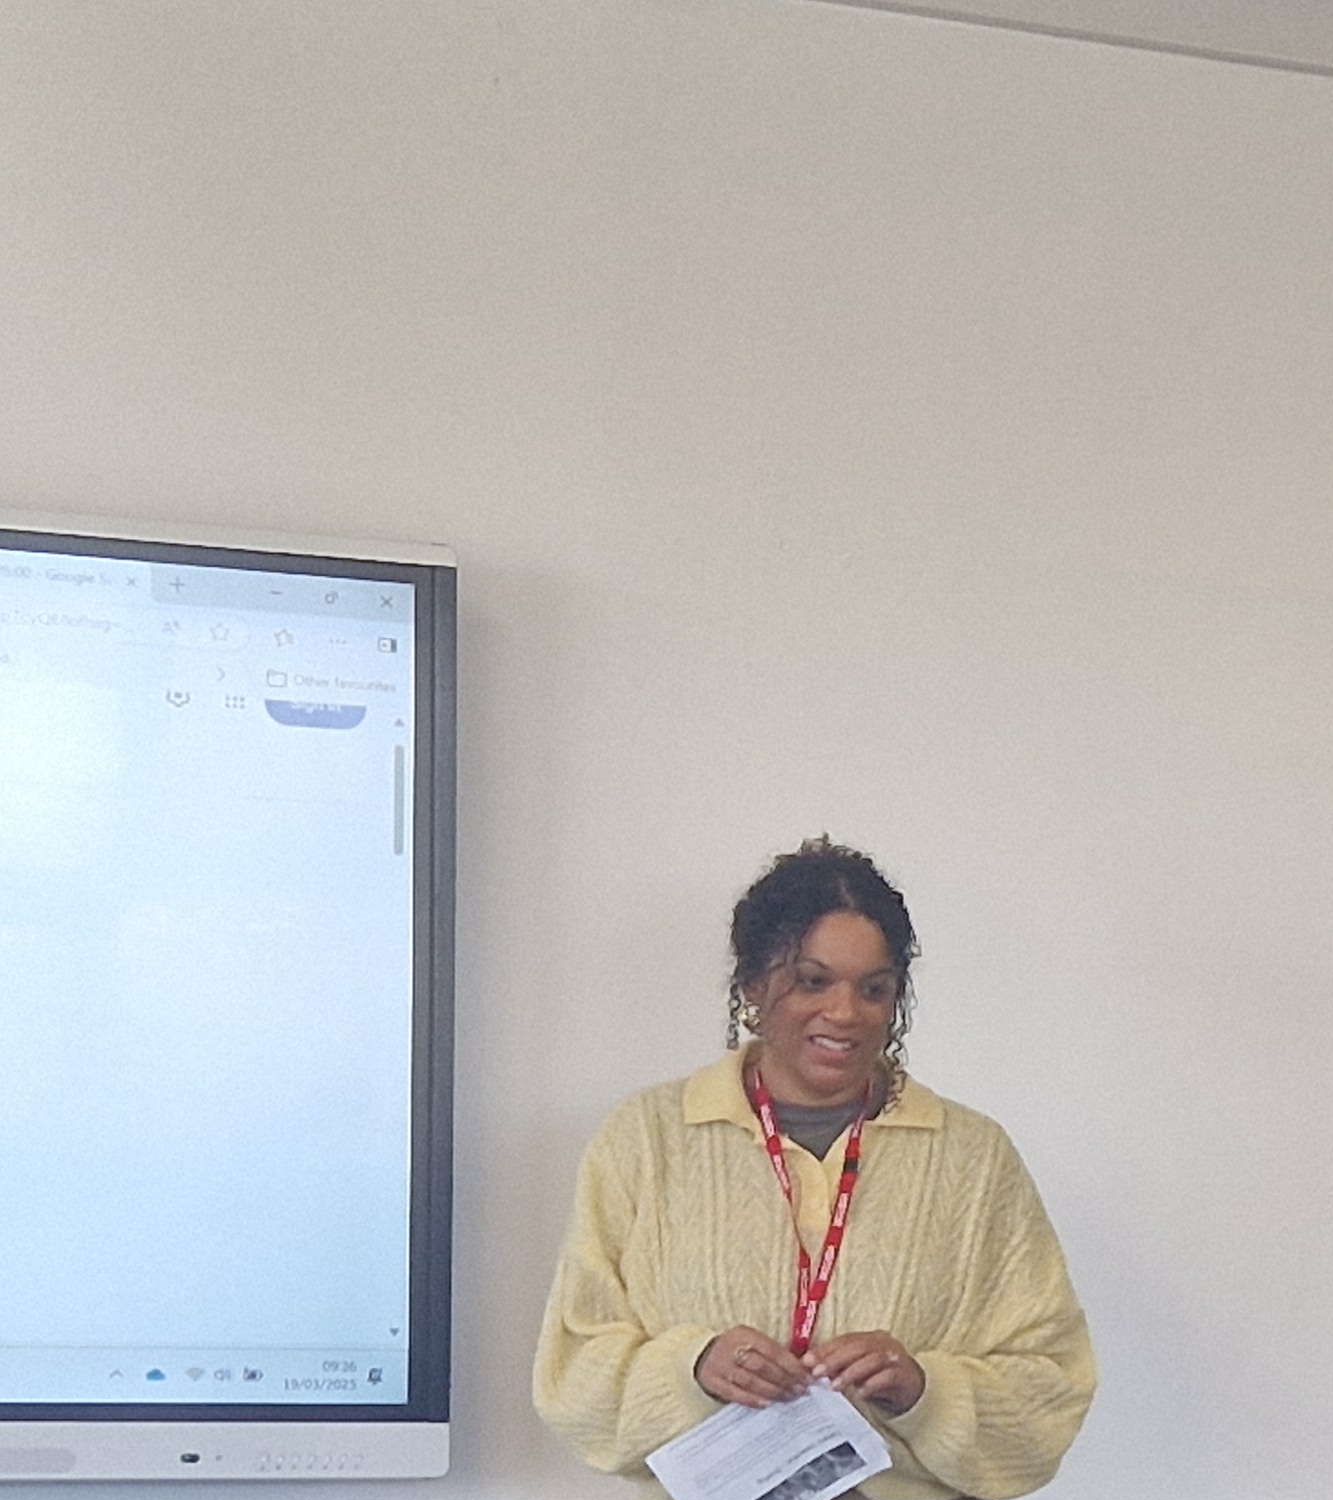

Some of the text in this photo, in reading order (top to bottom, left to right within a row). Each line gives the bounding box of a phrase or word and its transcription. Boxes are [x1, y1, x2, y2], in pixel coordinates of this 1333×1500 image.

[45, 567, 95, 585] Google
[293, 674, 397, 693] Other favourites
